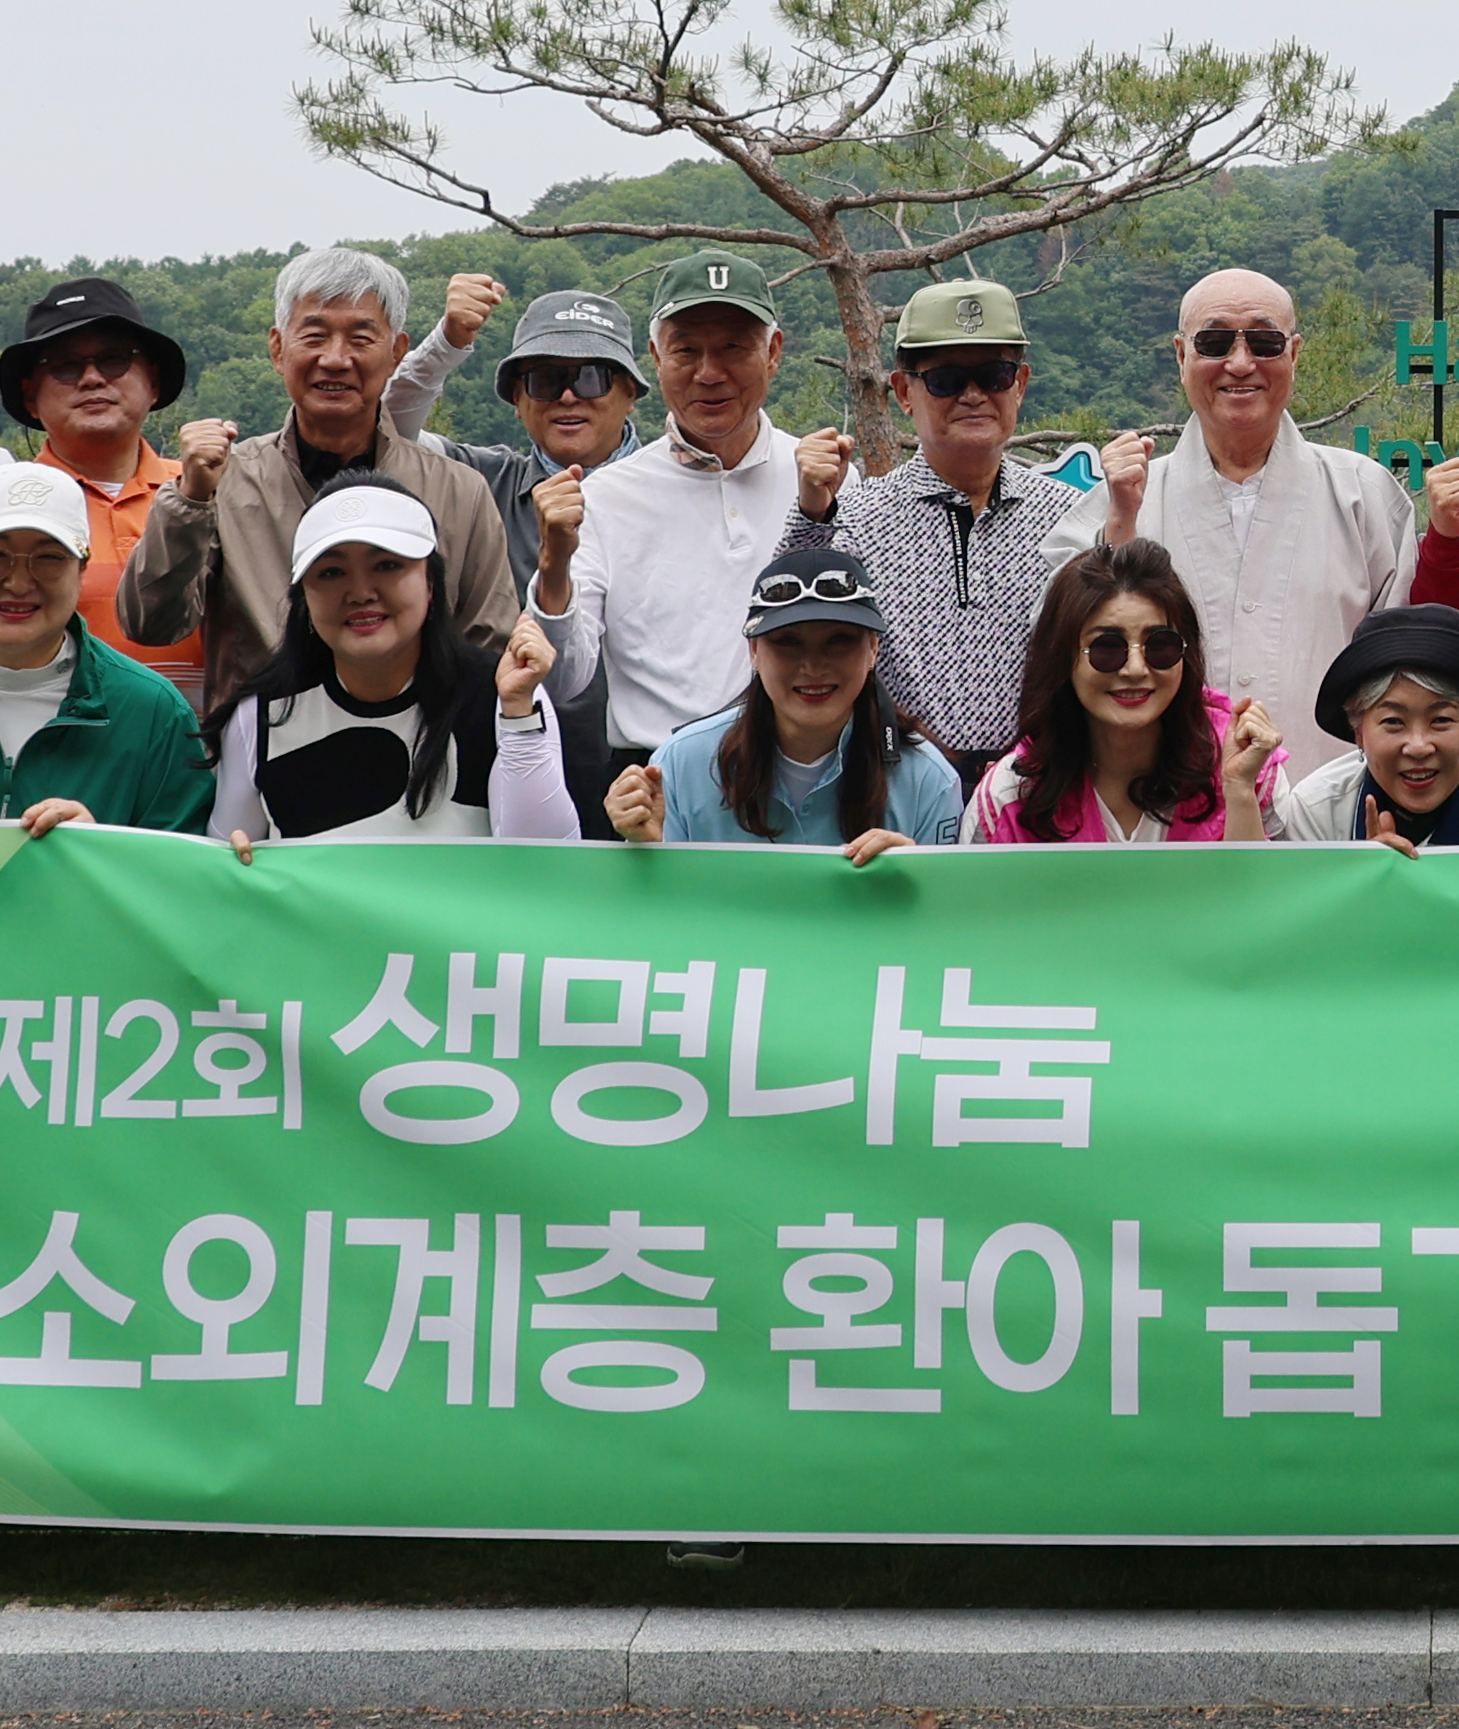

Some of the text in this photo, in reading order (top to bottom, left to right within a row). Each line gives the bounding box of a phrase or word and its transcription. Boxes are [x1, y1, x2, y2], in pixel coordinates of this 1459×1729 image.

[707, 266, 729, 290] U
[331, 952, 1112, 1149] 생명나눔
[770, 1212, 1163, 1415] 환아
